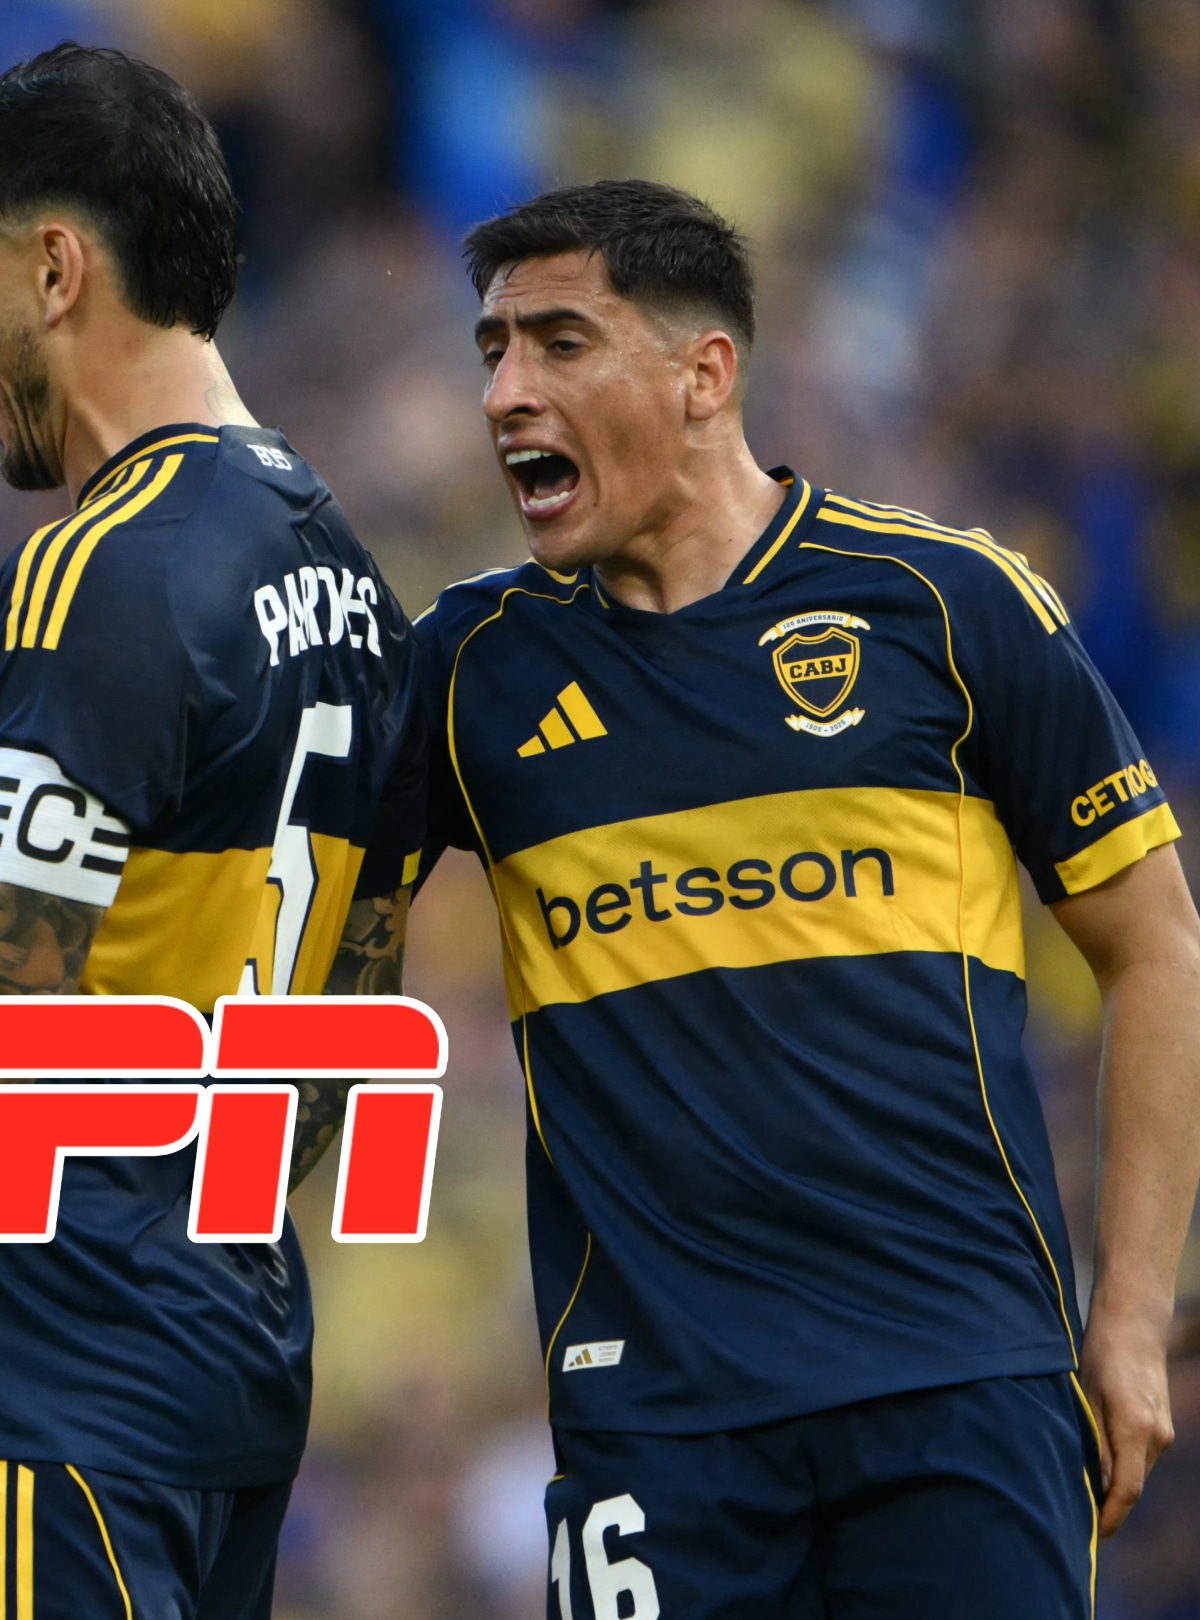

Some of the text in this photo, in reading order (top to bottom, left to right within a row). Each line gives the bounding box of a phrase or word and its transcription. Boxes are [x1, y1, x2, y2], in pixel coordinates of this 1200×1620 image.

[254, 566, 382, 667] PARDES
[796, 614, 844, 625] ANIVERSARIO
[789, 658, 847, 679] CABJ
[16, 783, 87, 864] C
[535, 847, 895, 951] betsson
[551, 1493, 660, 1620] 16
